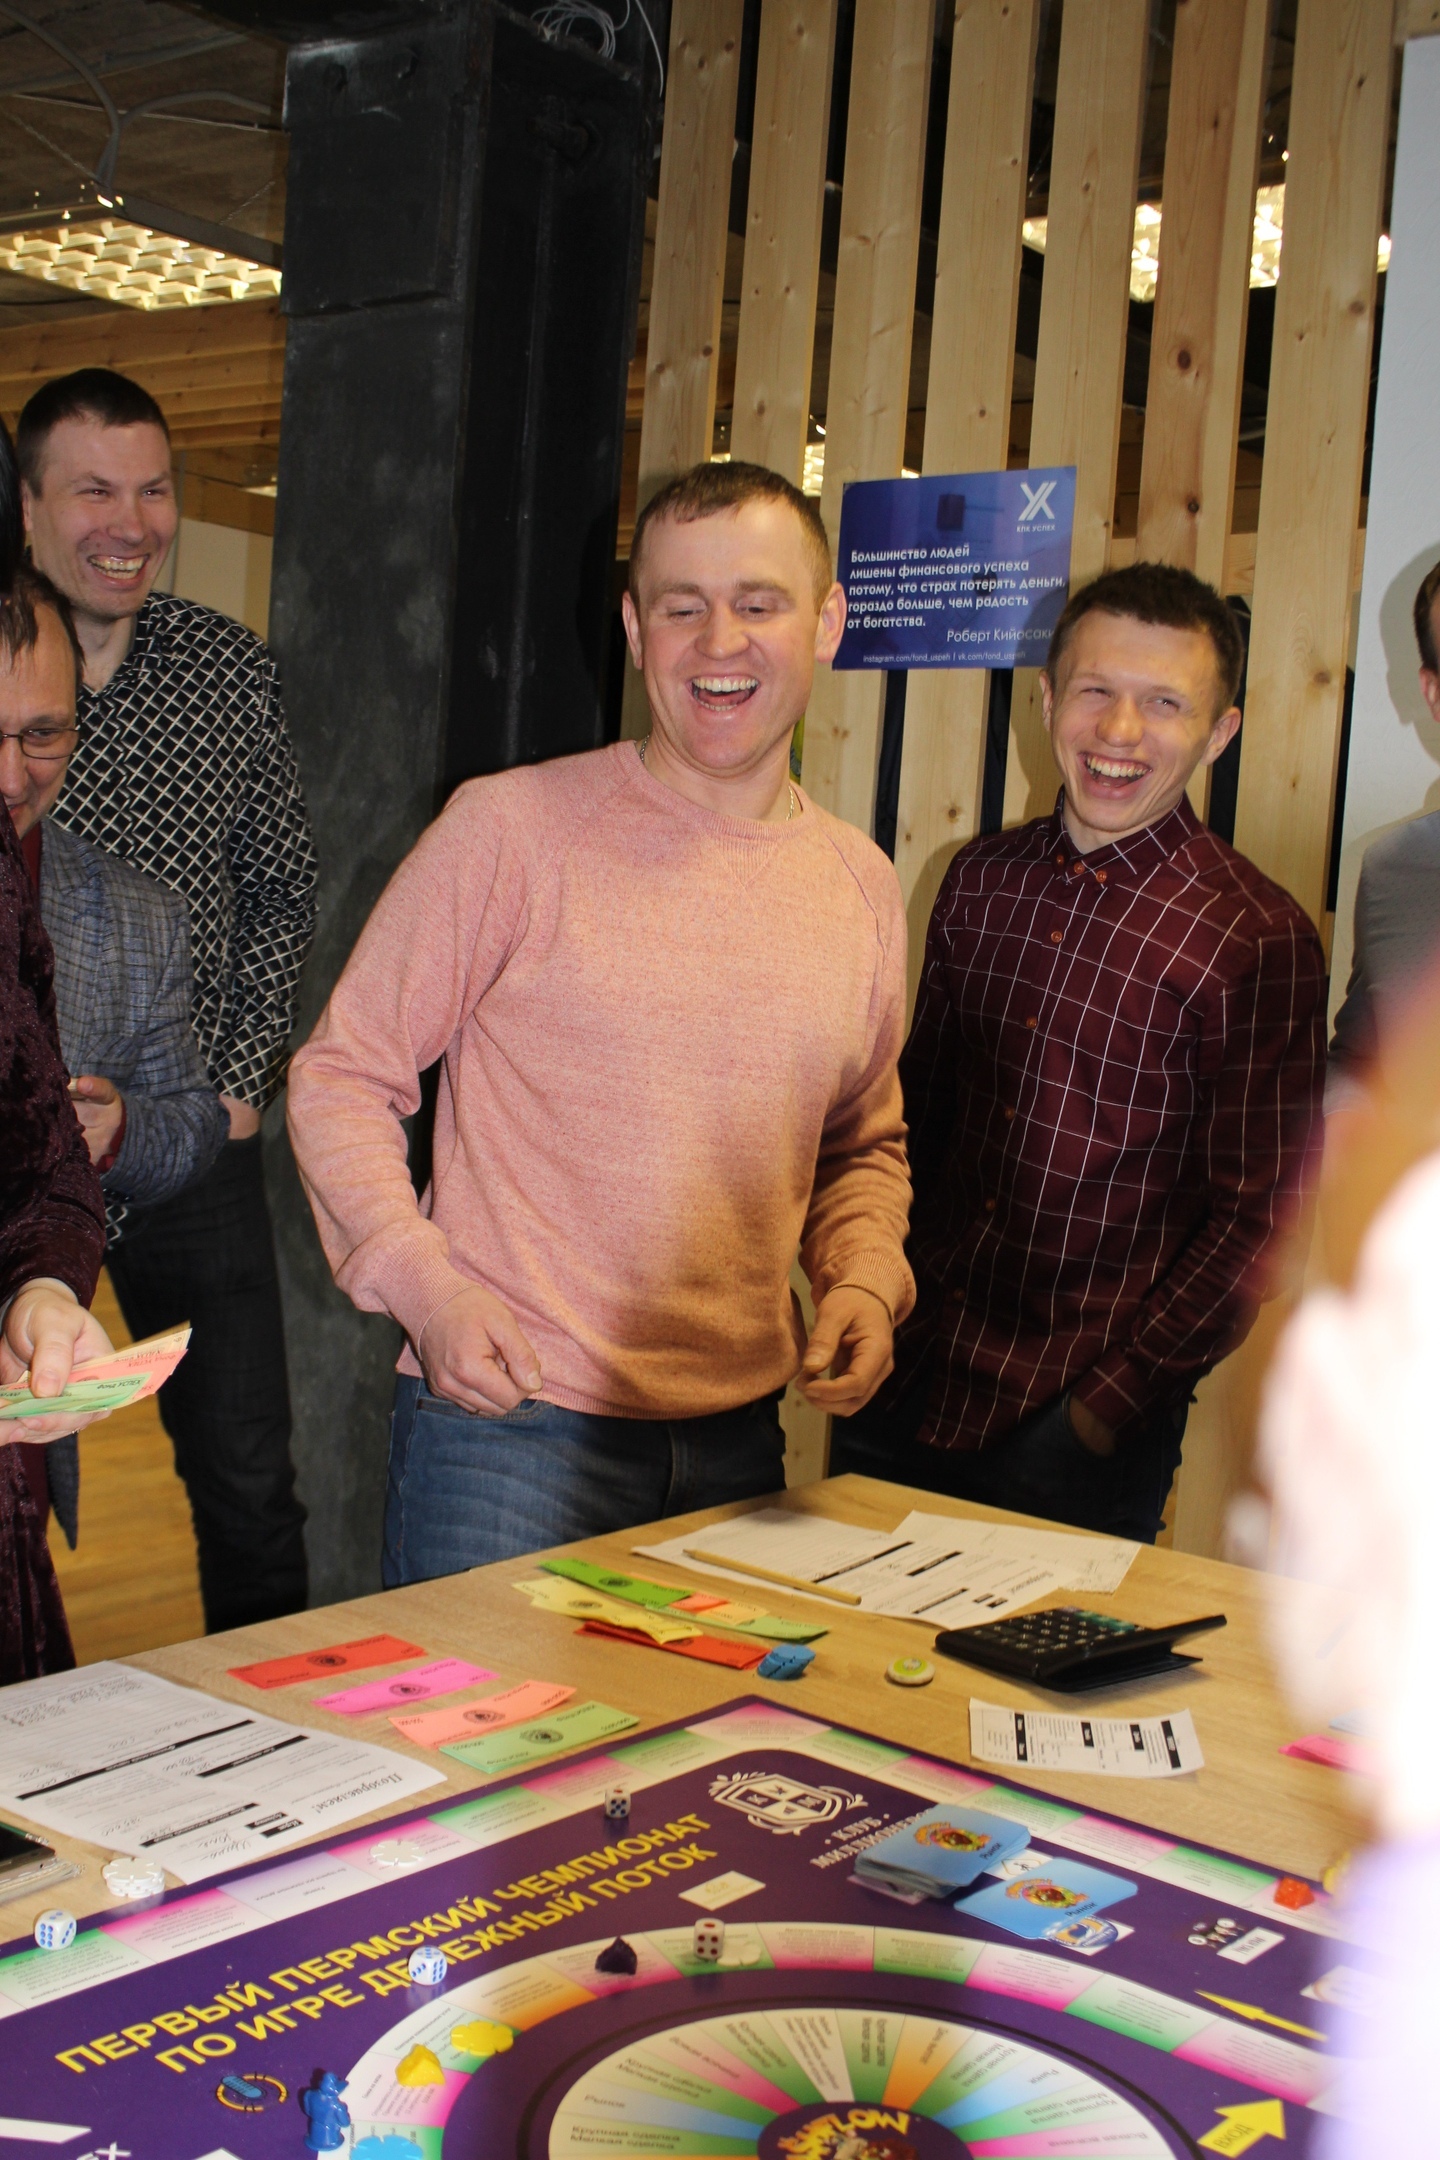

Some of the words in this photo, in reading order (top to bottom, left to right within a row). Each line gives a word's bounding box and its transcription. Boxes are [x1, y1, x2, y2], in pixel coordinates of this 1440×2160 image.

[851, 550, 927, 563] Большинство
[930, 544, 970, 559] людей
[850, 568, 895, 579] лишены
[898, 562, 980, 579] финансового
[984, 559, 1029, 573] успеха
[849, 584, 894, 596] потому,
[897, 582, 917, 593] что
[920, 581, 956, 594] страх
[960, 577, 1015, 592] потерять
[1019, 575, 1066, 590] деньги,
[848, 600, 894, 613] гораздо
[897, 596, 945, 611] больше,
[948, 597, 972, 608] чем
[975, 594, 1028, 610] радость
[847, 618, 861, 629] от
[863, 614, 926, 629] богатства.
[946, 628, 990, 643] Роберт
[863, 653, 951, 663] instagram.com/fond_uspeh
[315, 1772, 402, 1815] Поздравляем!
[831, 1816, 882, 1841] КЛУБ
[1065, 1902, 1098, 1917] Рынок
[55, 1980, 260, 2074] ПЕРВЫЙ
[268, 1896, 502, 1993] ПЕРМСКИЙ
[493, 1812, 712, 1900] ЧЕМПИОНАТ
[156, 2029, 236, 2074] ПО
[242, 1983, 364, 2042] ИГРЕ
[360, 1890, 598, 1996] ДЕЕЖНЫЙ
[589, 1842, 718, 1900] ПОТОК
[1213, 2122, 1254, 2150] ВХОД
